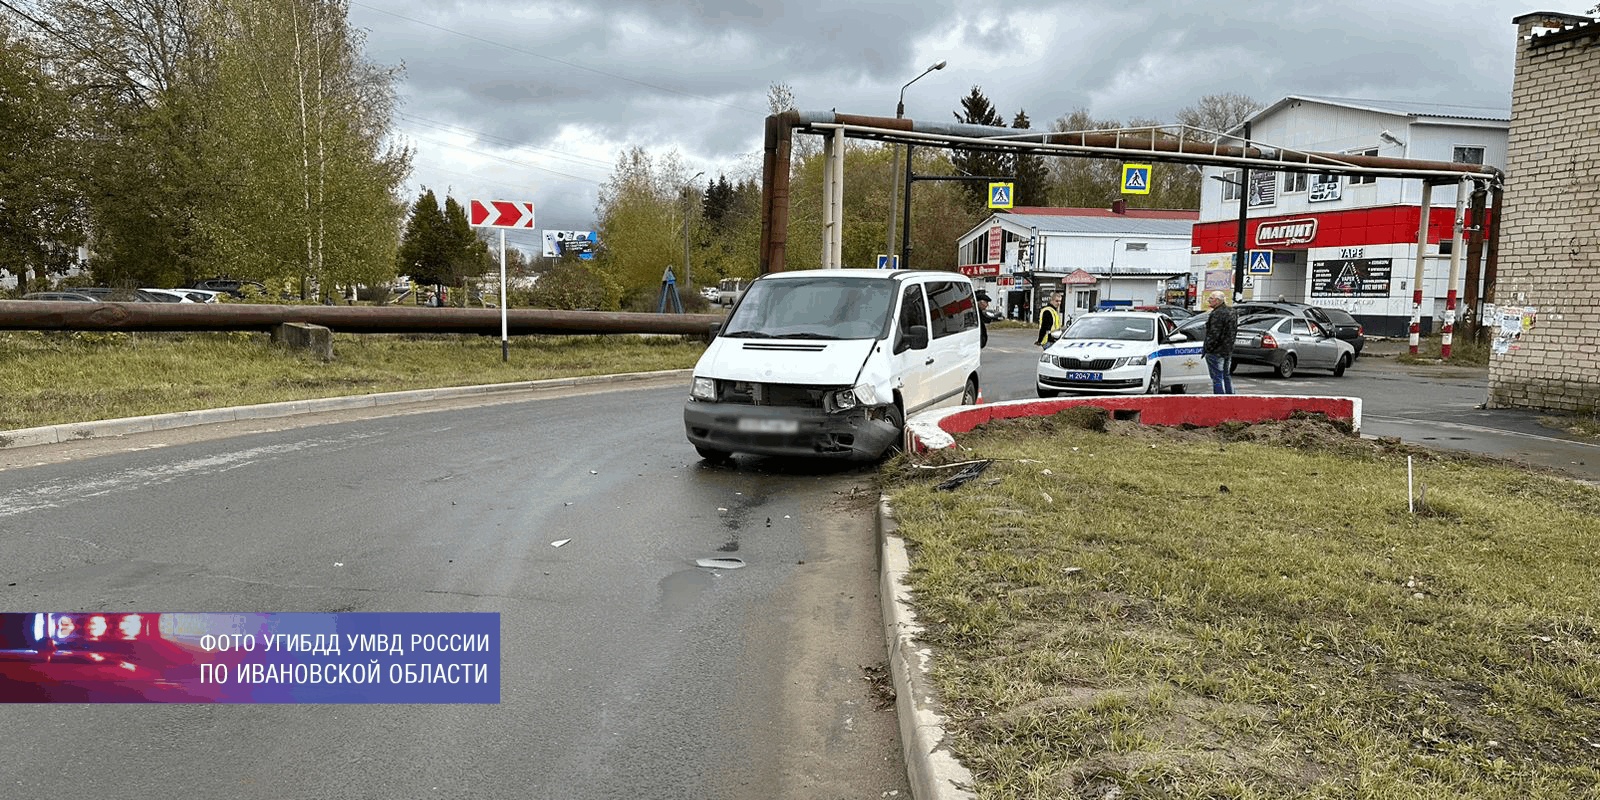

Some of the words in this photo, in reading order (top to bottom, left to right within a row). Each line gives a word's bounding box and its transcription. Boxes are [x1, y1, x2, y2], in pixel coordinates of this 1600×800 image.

[1259, 223, 1313, 240] МАГНИТ
[1064, 341, 1125, 349] ДПС
[1075, 372, 1091, 380] 2047
